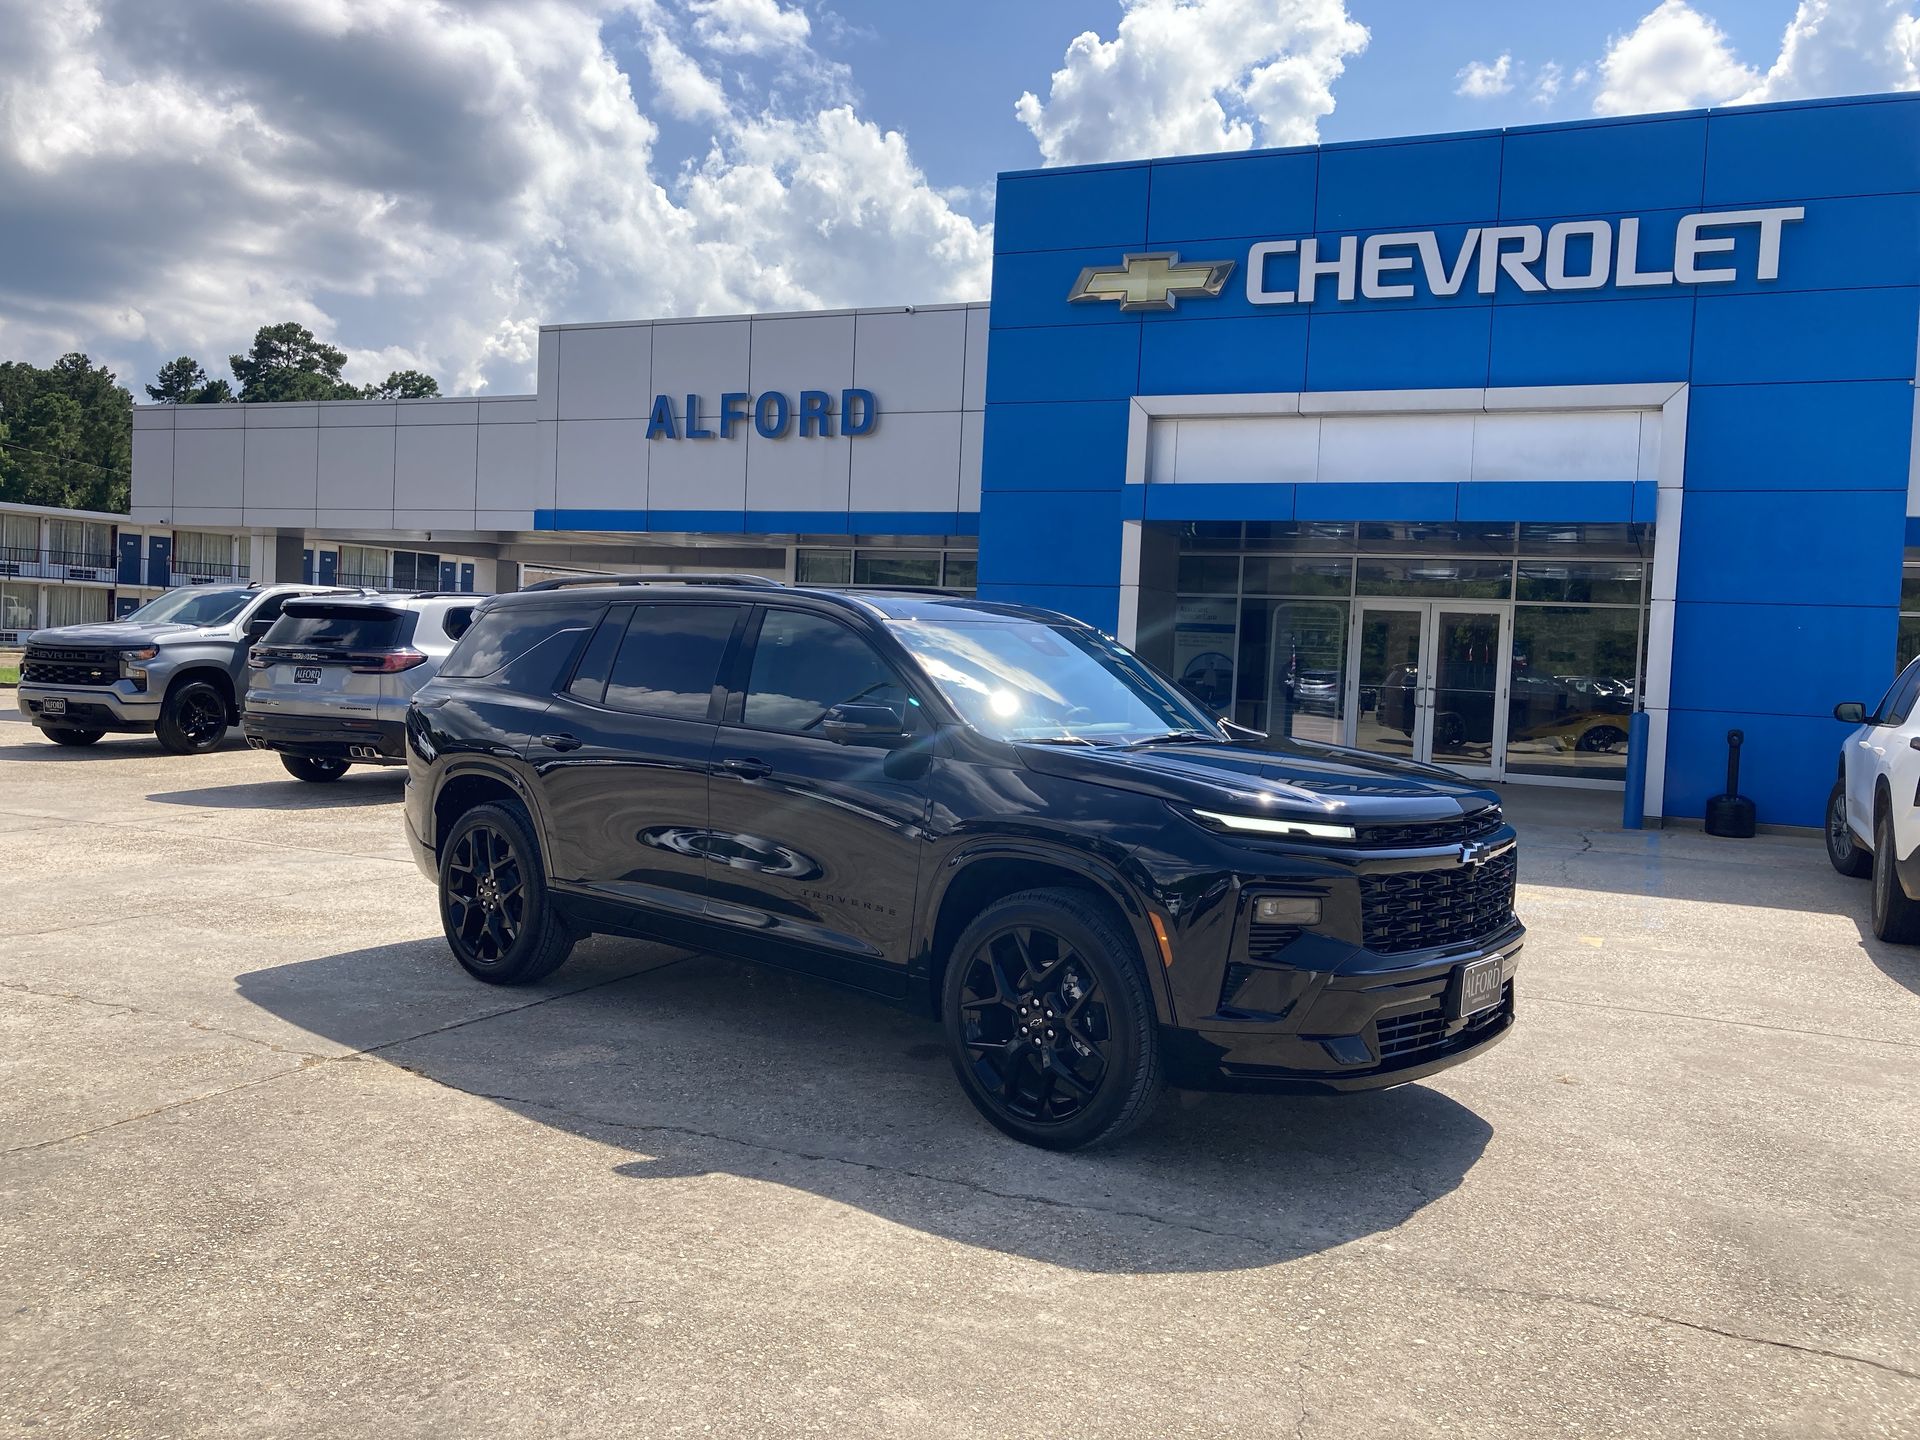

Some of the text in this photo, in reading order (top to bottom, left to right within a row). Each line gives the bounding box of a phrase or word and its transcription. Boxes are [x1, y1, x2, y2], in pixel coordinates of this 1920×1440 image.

[1246, 206, 1805, 306] CHEVROLET
[645, 388, 878, 440] ALFORD
[26, 649, 105, 661] CHEVROLET
[292, 652, 318, 661] GMC
[295, 669, 321, 679] ALFORD
[45, 700, 64, 709] ALFORD
[800, 888, 897, 916] TRAVERSE
[1464, 968, 1500, 999] ALFORD
